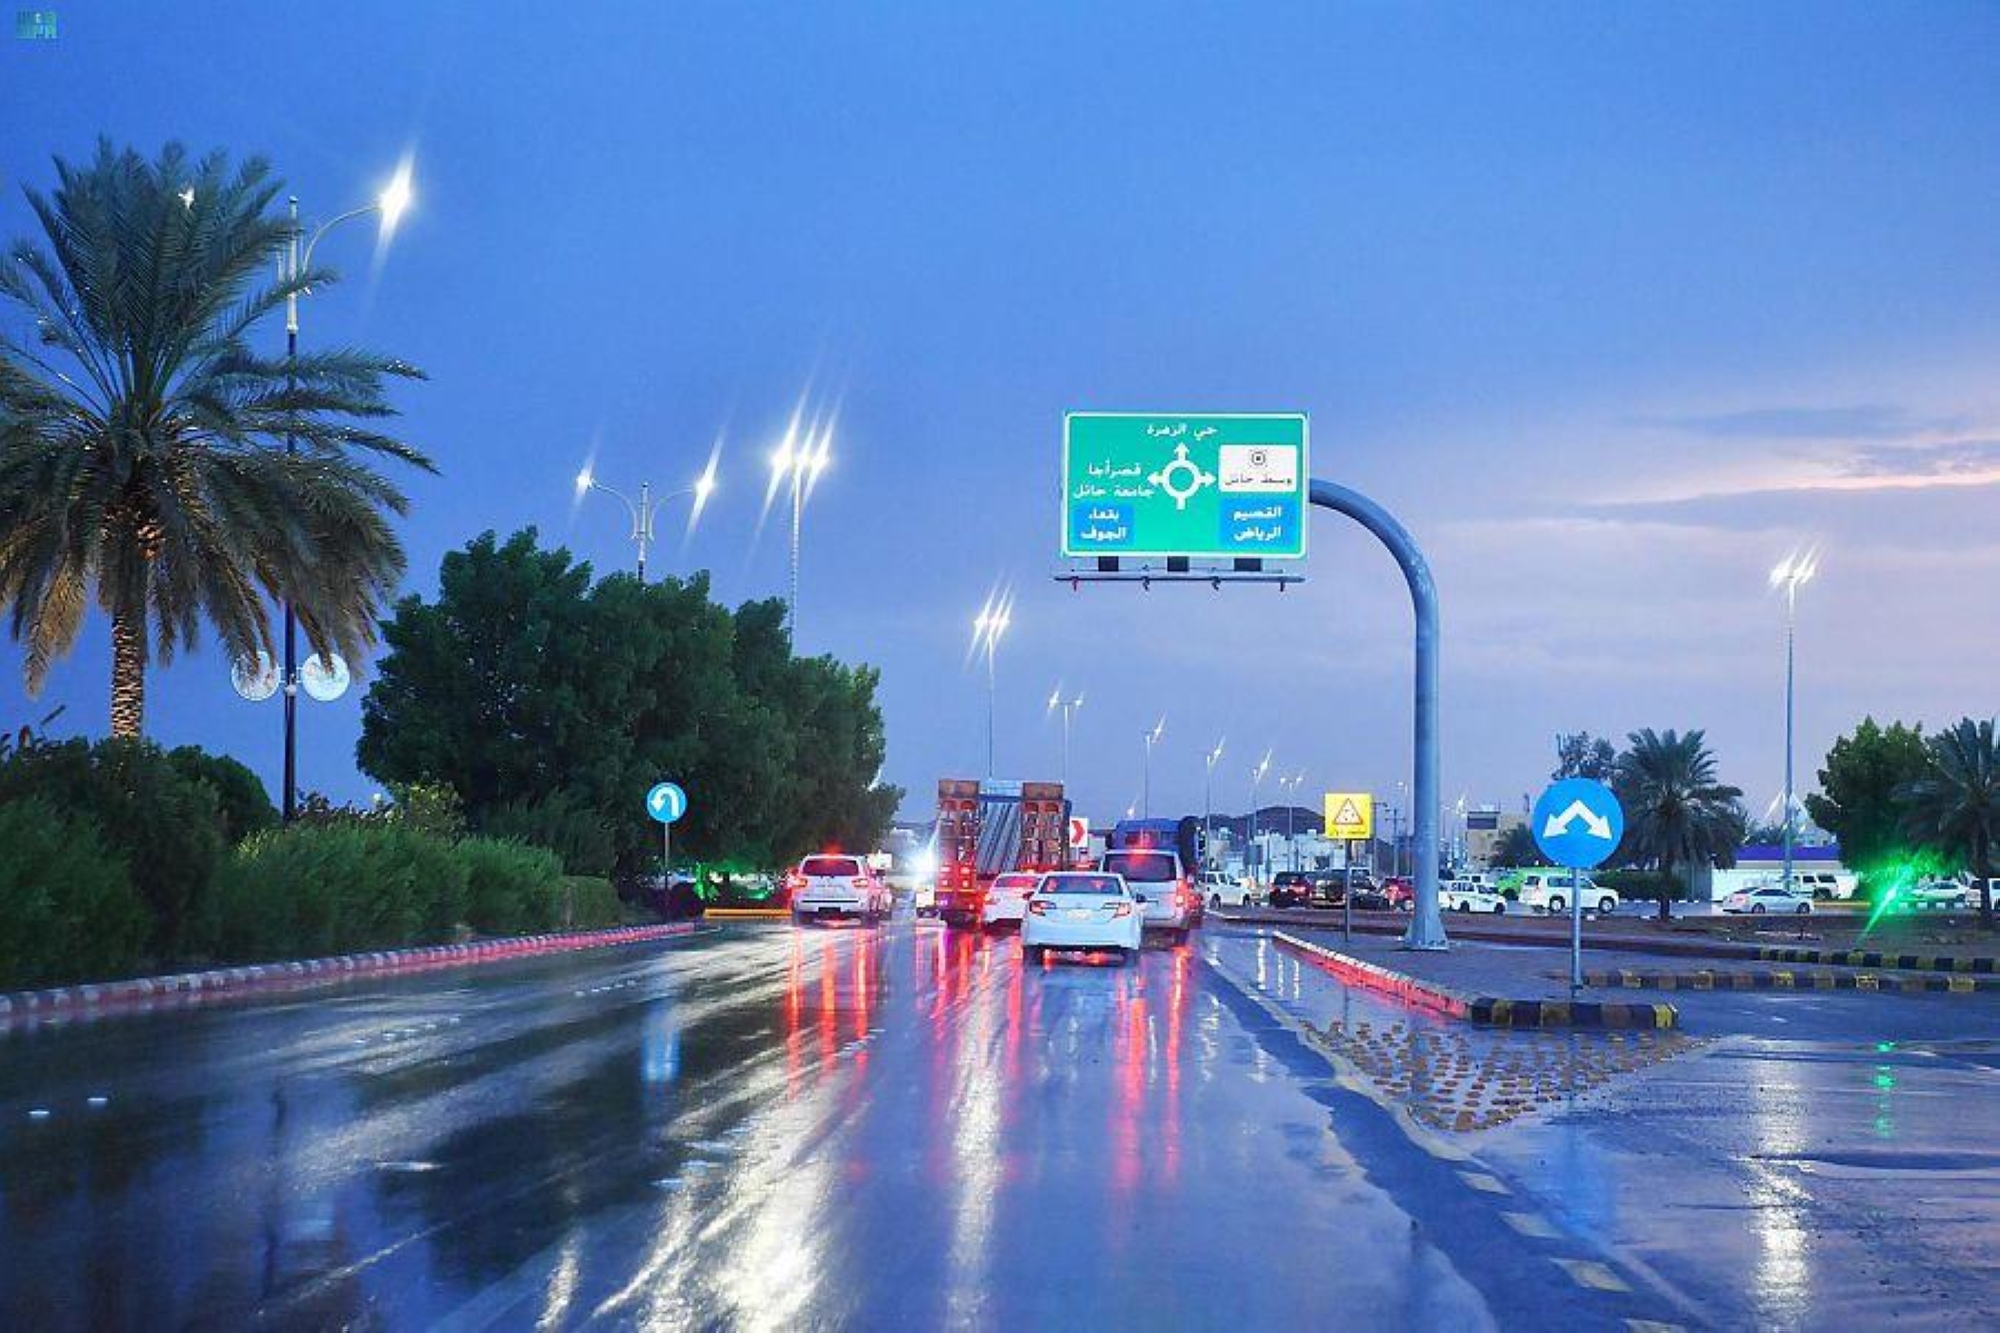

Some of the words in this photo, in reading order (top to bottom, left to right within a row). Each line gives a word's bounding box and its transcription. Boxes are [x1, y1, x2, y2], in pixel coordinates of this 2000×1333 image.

[1193, 426, 1219, 442] حي
[1073, 484, 1107, 500] حائل
[1114, 484, 1155, 500] جامعة
[1233, 506, 1282, 522] القصيم
[1080, 525, 1127, 541] الجوف
[1233, 525, 1282, 542] الرياض
